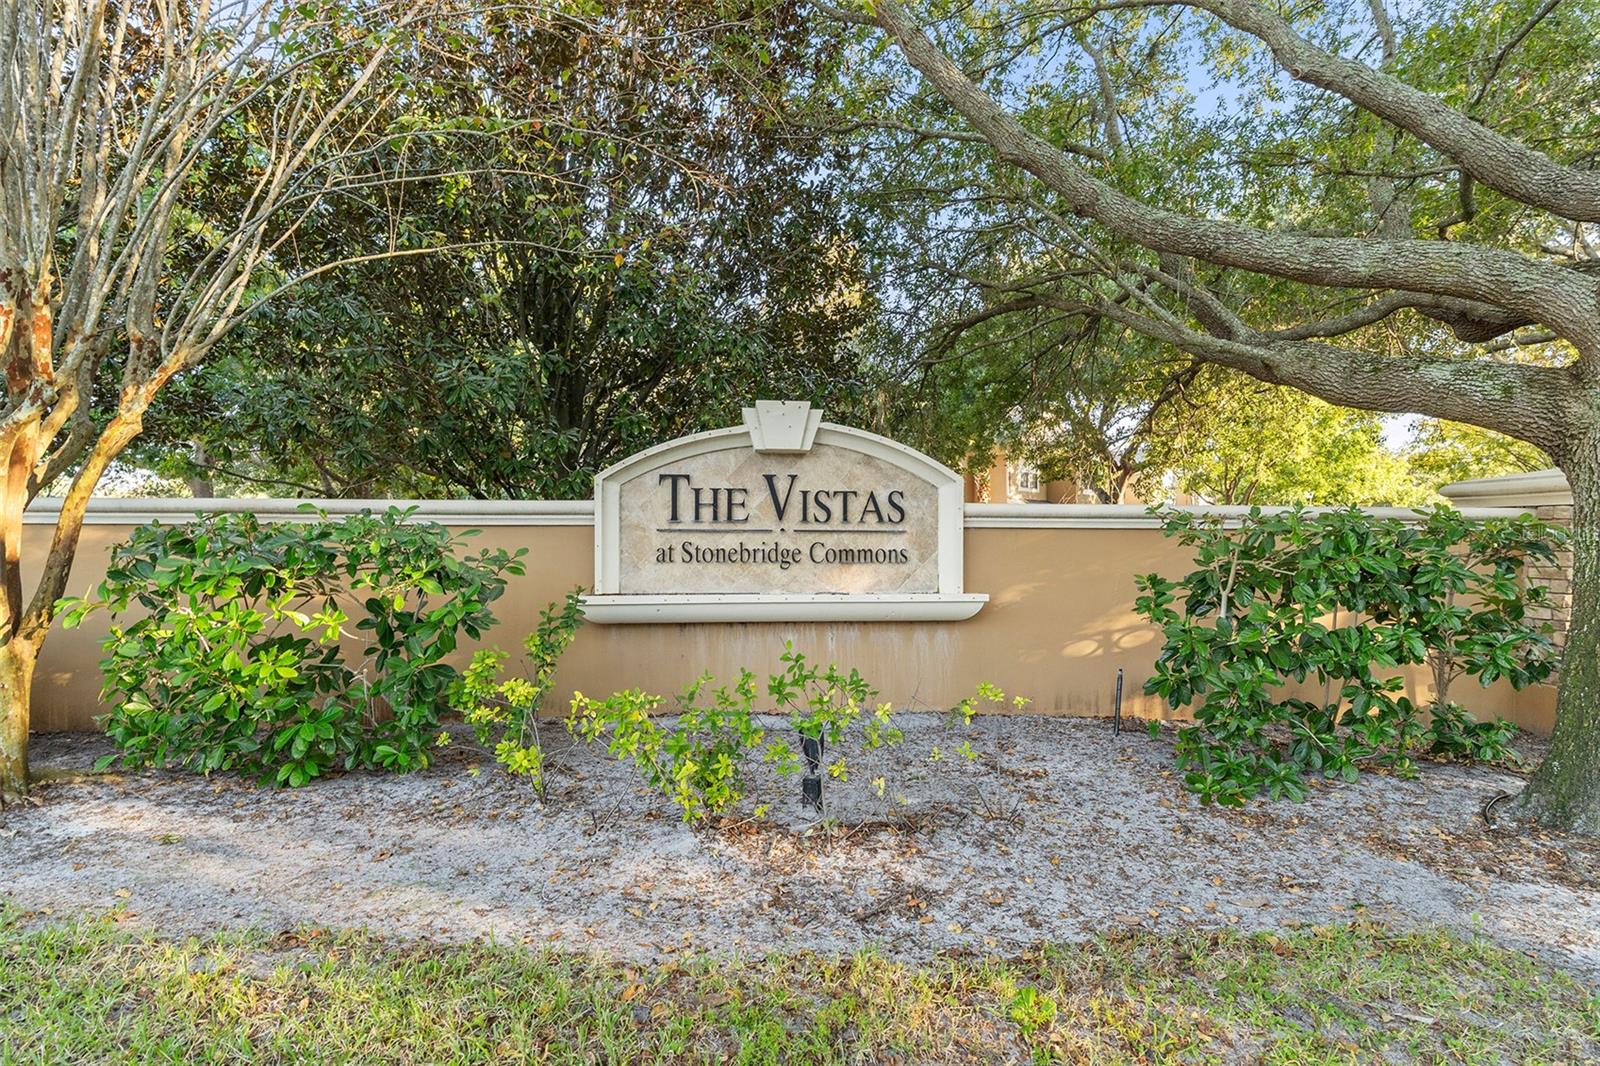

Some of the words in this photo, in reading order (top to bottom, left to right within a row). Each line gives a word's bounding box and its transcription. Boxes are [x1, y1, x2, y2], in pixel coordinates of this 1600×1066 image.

[658, 473, 750, 522] THE
[762, 473, 906, 524] VISTAS
[656, 545, 674, 563] at
[681, 541, 802, 569] Stonebridge
[809, 541, 908, 564] Commons
